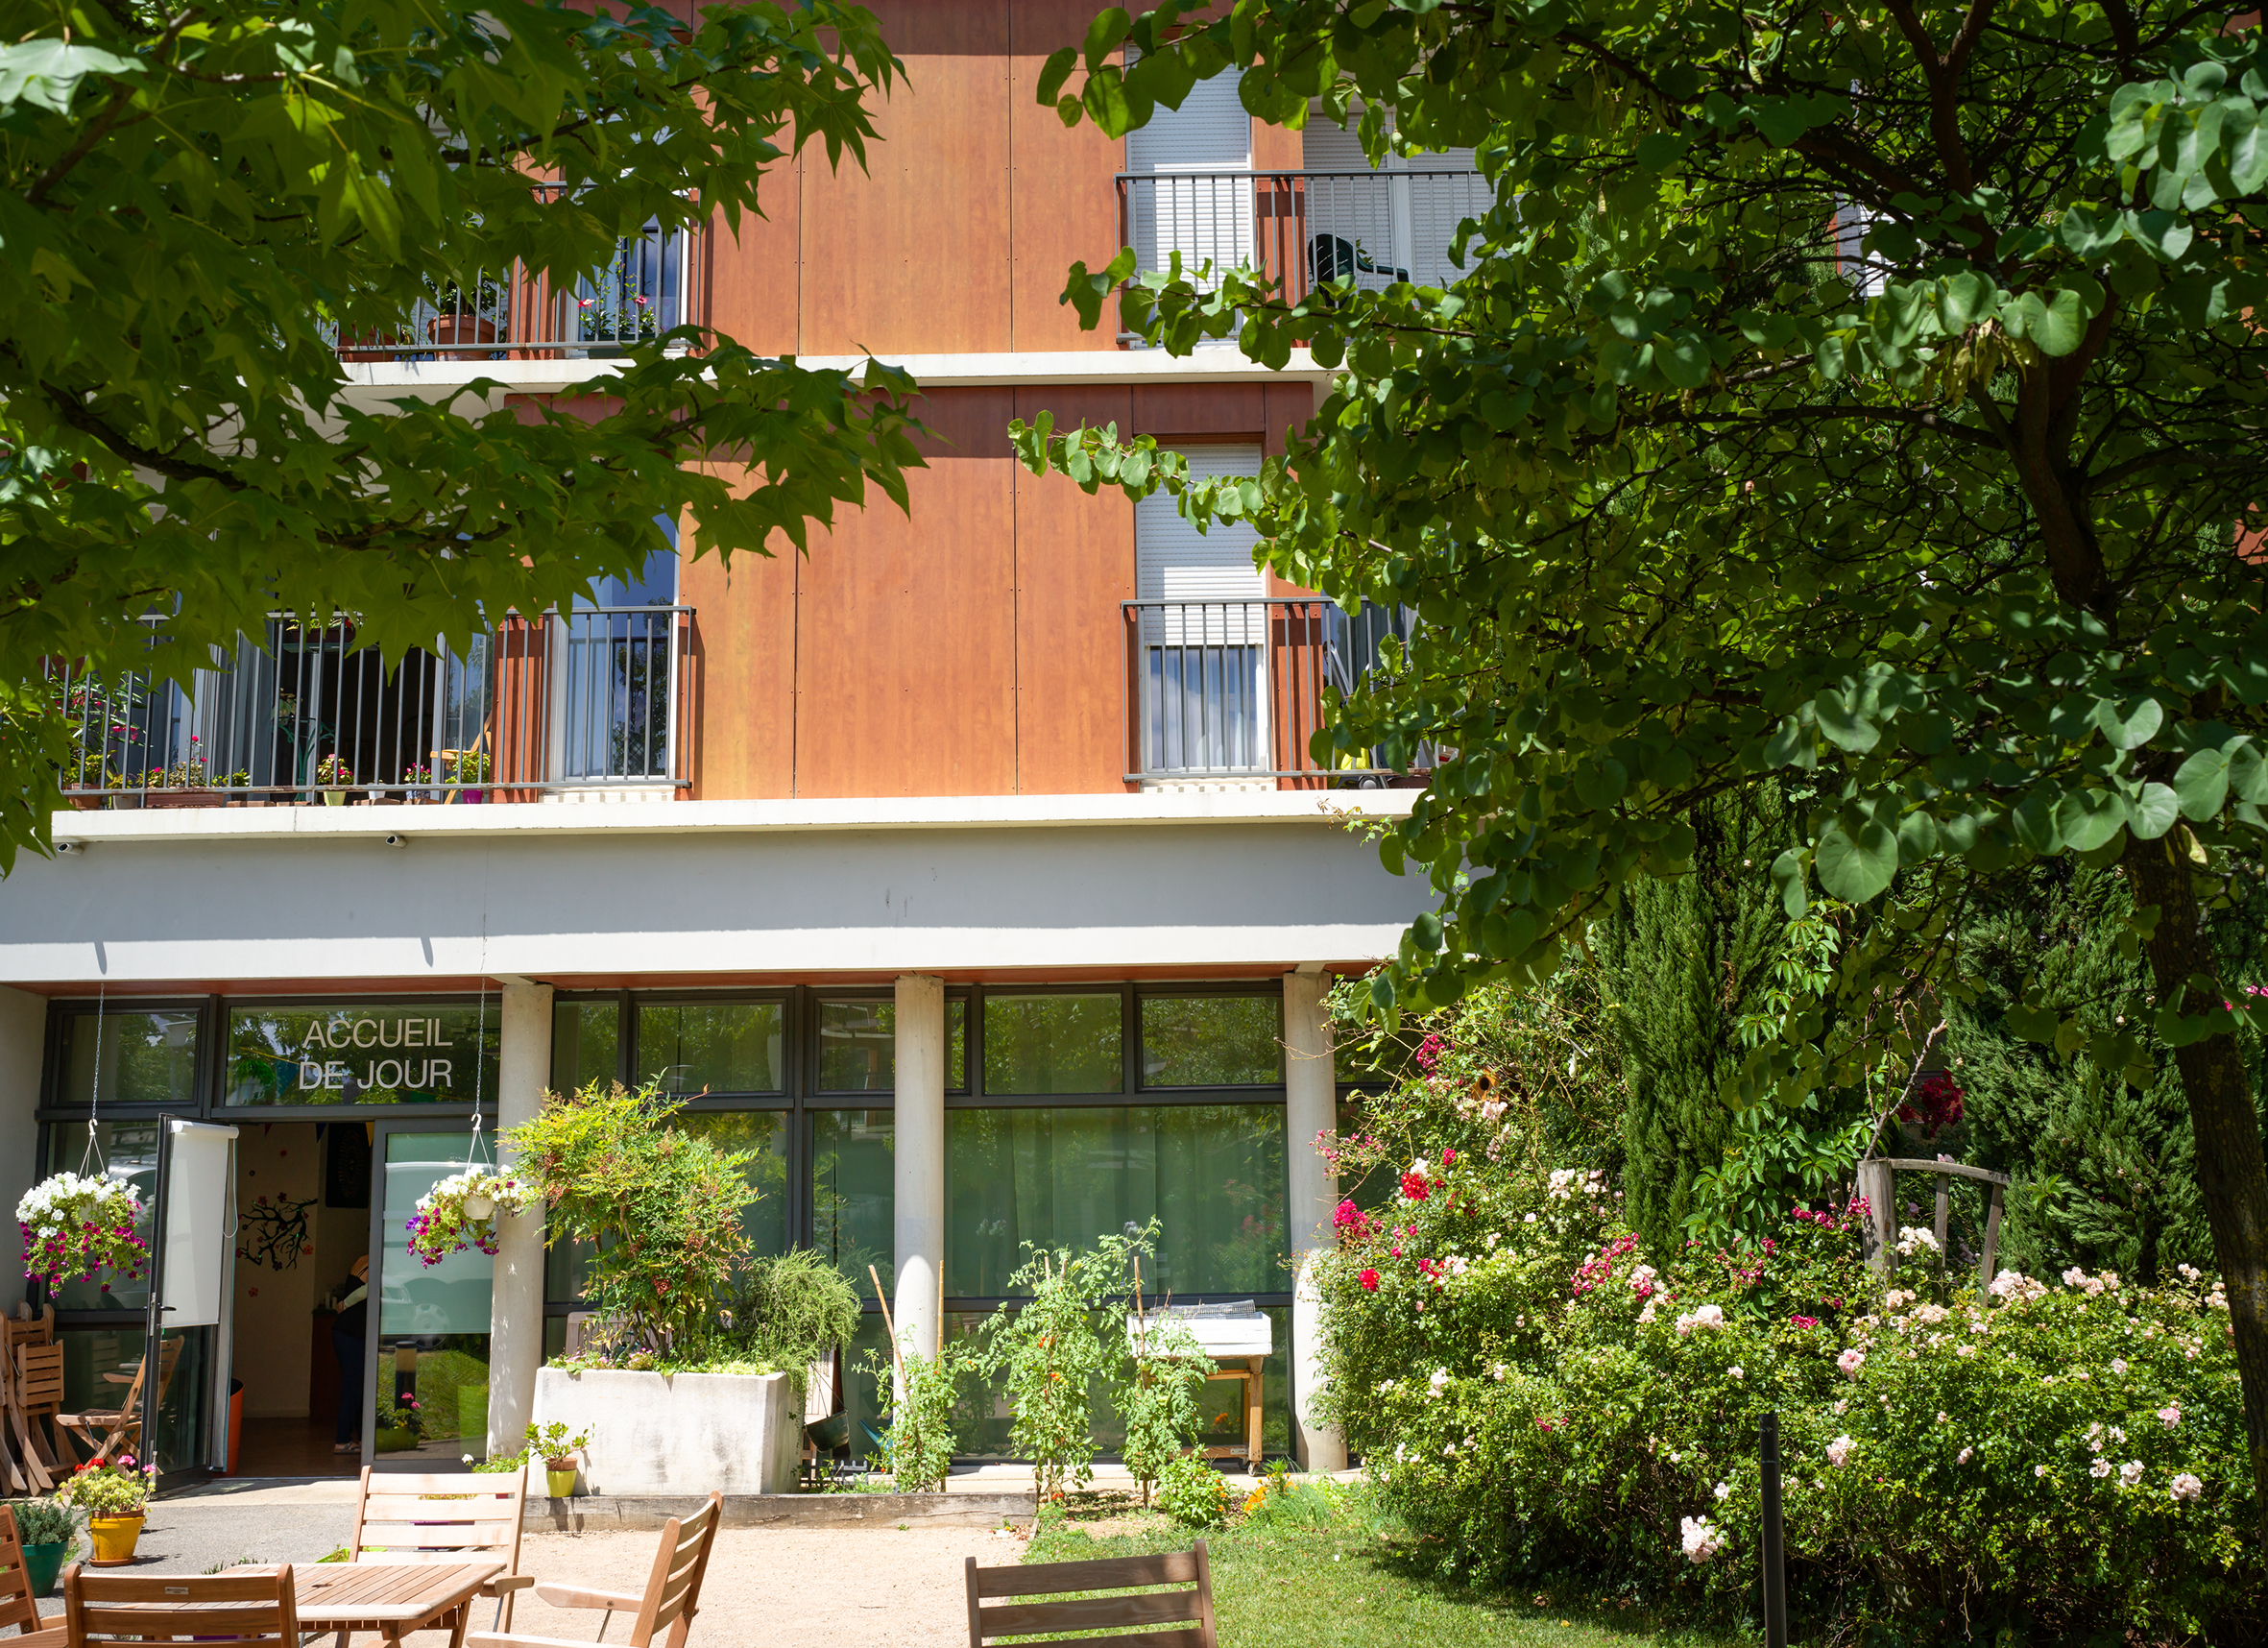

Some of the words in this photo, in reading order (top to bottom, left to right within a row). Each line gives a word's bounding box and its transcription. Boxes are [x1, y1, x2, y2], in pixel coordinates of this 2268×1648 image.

[302, 1018, 453, 1049] ACCUEIL
[299, 1060, 345, 1090] DE
[357, 1059, 452, 1089] JOUR
